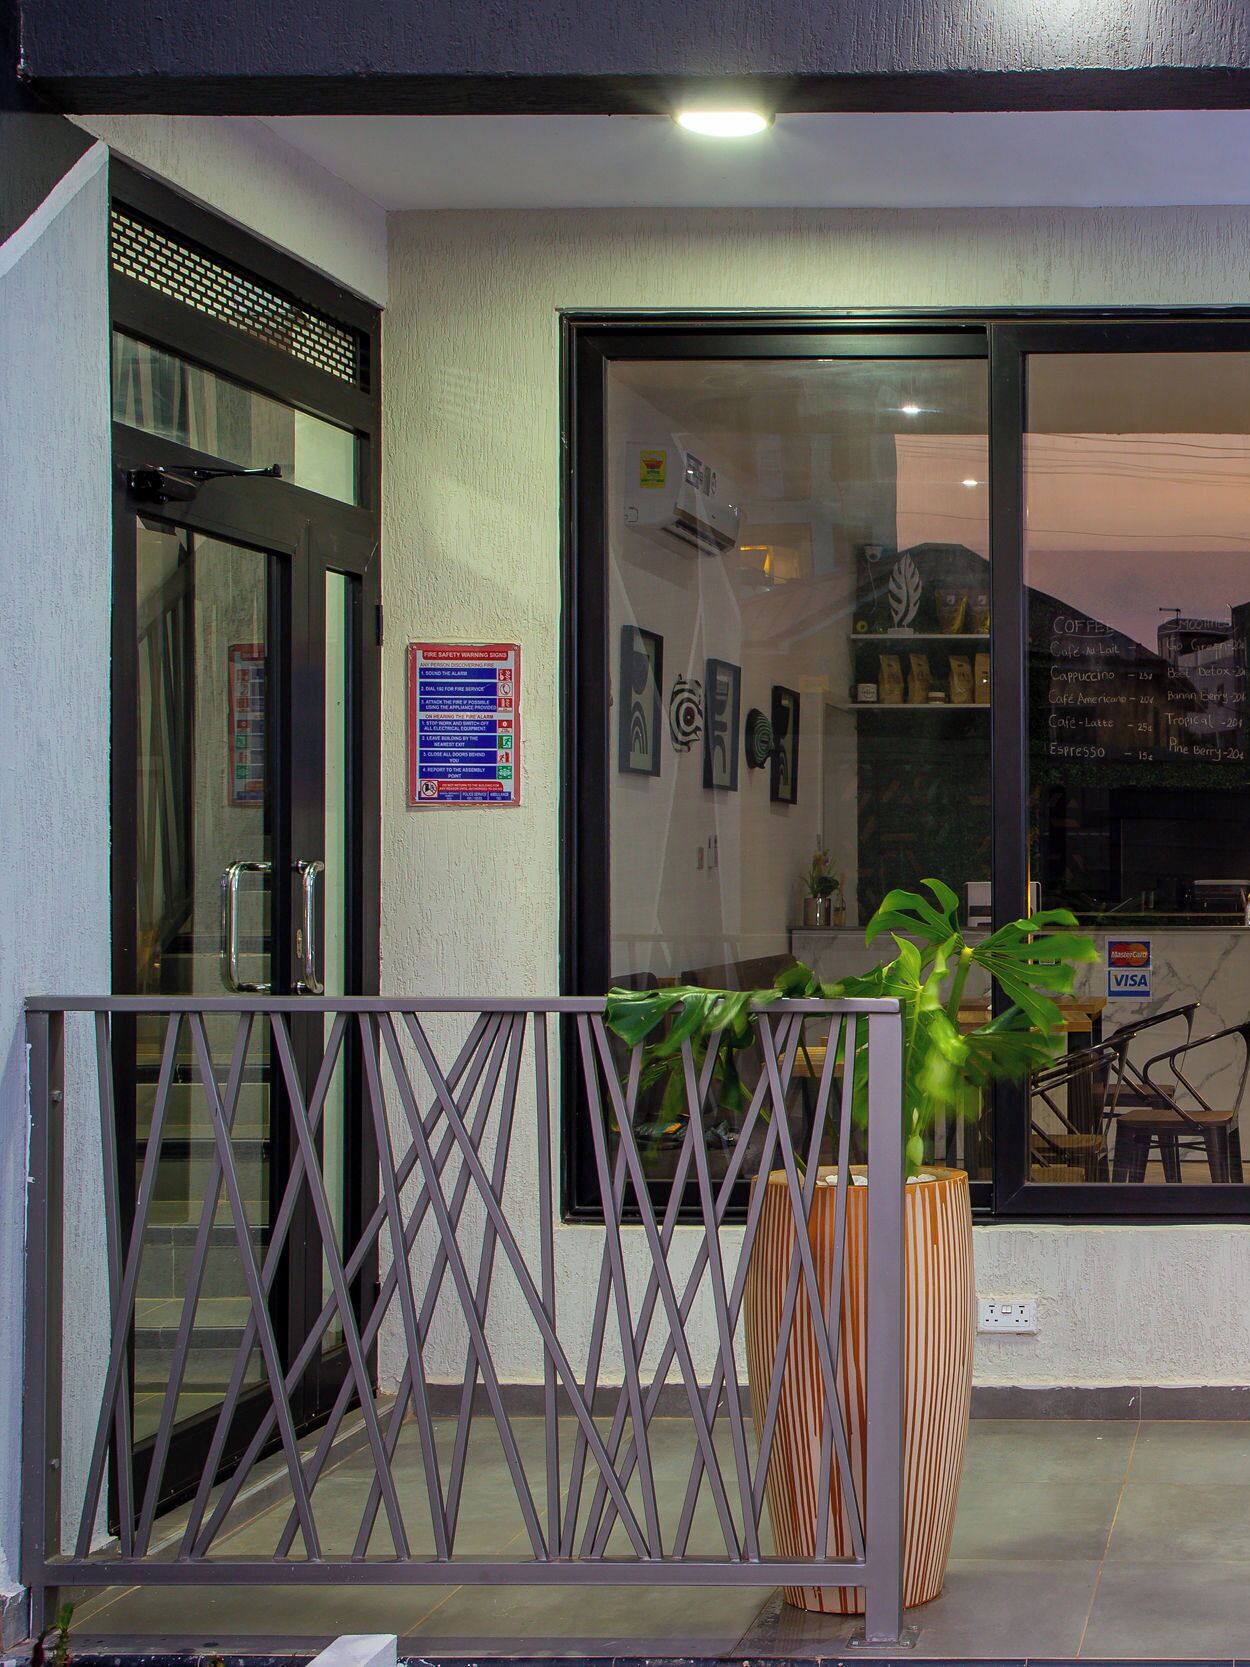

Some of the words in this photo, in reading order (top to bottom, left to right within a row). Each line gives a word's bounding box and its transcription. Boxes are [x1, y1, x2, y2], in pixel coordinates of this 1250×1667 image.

[1053, 616, 1116, 634] COFFEE
[1050, 665, 1115, 684] Cappuccino
[1199, 666, 1231, 677] Detox
[1049, 690, 1075, 705] Café
[1077, 692, 1127, 705] Americano
[1200, 692, 1228, 705] Berry
[1164, 712, 1214, 728] Tropical
[1050, 742, 1106, 758] Espresso
[1169, 737, 1189, 754] Pine
[1193, 746, 1222, 762] Berry
[1111, 951, 1148, 959] MasterCard
[1112, 974, 1148, 987] VISA
